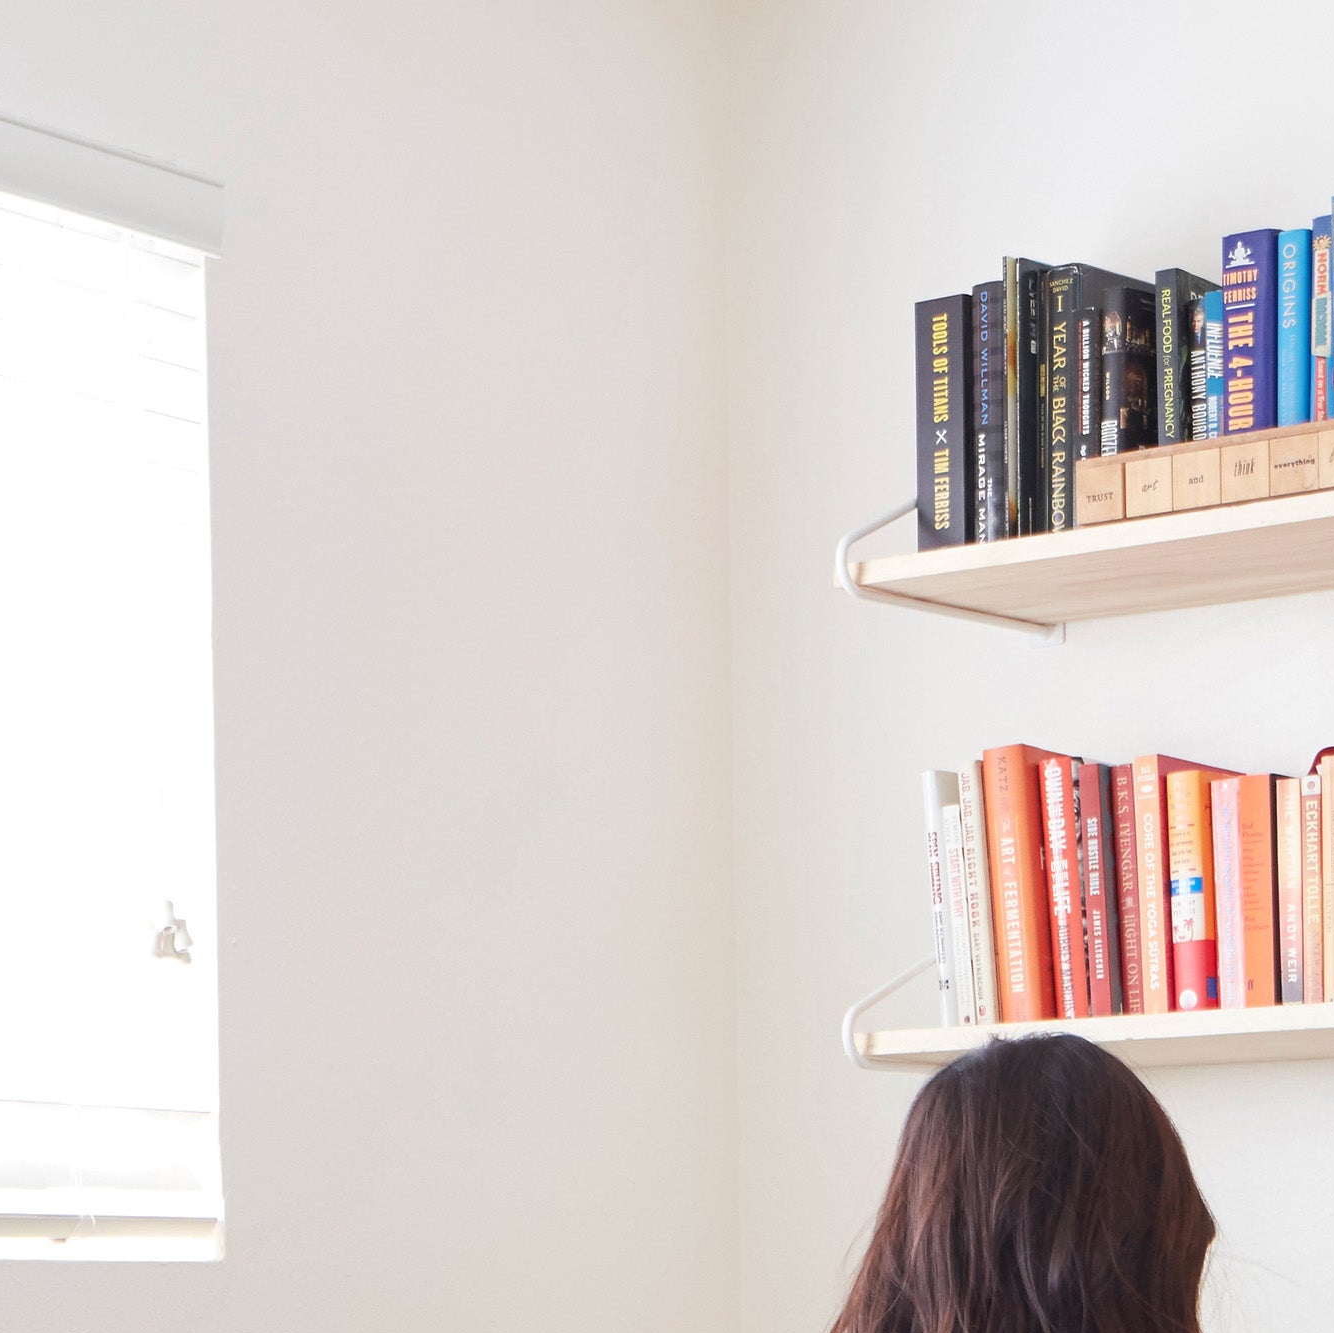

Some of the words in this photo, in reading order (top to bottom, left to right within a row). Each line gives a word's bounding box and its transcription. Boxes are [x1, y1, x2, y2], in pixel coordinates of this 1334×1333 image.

[1052, 285, 1069, 293] DAVID
[1222, 268, 1259, 287] TIMOTHY
[1282, 243, 1297, 329] ORIGINS
[1317, 252, 1328, 297] NORM
[1161, 288, 1171, 317] REAL
[1223, 287, 1257, 304] FERRISS
[932, 312, 948, 354] TOOLS
[980, 291, 989, 342] DAVID
[1227, 311, 1254, 350] THE
[1051, 321, 1067, 371] YEAR
[1082, 329, 1090, 359] BILLION
[1162, 319, 1172, 353] FOOD
[1206, 322, 1223, 379] INFLUENCE
[932, 356, 949, 374] OF
[1059, 376, 1066, 389] OF
[1082, 361, 1090, 392] WICKED
[1190, 350, 1206, 399] ANTHONY
[933, 376, 949, 424] TITANS
[980, 347, 989, 426] WILLMAN
[1163, 368, 1175, 439] PREGNANCY
[1227, 356, 1254, 431] 4-HOUR
[1051, 396, 1066, 446] BLACK
[1082, 394, 1090, 436] THOUGHTS
[934, 447, 949, 474] TIM
[978, 433, 986, 501] MIRAGE
[1086, 492, 1114, 503] TRUST
[1141, 479, 1159, 494] art
[1188, 474, 1205, 486] and
[1233, 459, 1255, 478] think
[1273, 457, 1316, 471] everything
[934, 477, 950, 530] FERRISS
[978, 508, 986, 544] MAN
[997, 757, 1008, 792] KATZ
[1116, 777, 1128, 817] B.K.S.
[1087, 817, 1099, 837] SIDE
[1306, 801, 1319, 872] ECKHART
[948, 849, 959, 874] START
[1088, 840, 1100, 870] HUSTLE
[1119, 822, 1134, 892] IYENGAR
[951, 875, 961, 898] WITH
[1053, 882, 1071, 917] LIFE
[1089, 872, 1101, 896] BIBLE
[1306, 875, 1320, 924] TOLLE
[953, 899, 964, 919] WHY
[1092, 909, 1102, 936] JAMES
[1286, 904, 1297, 942] ANDY
[1124, 914, 1138, 959] LIGHT
[1094, 939, 1105, 980] ALTUCHER
[1126, 963, 1139, 986] ON
[1287, 947, 1298, 983] WEIR
[1128, 990, 1142, 1014] LIF
